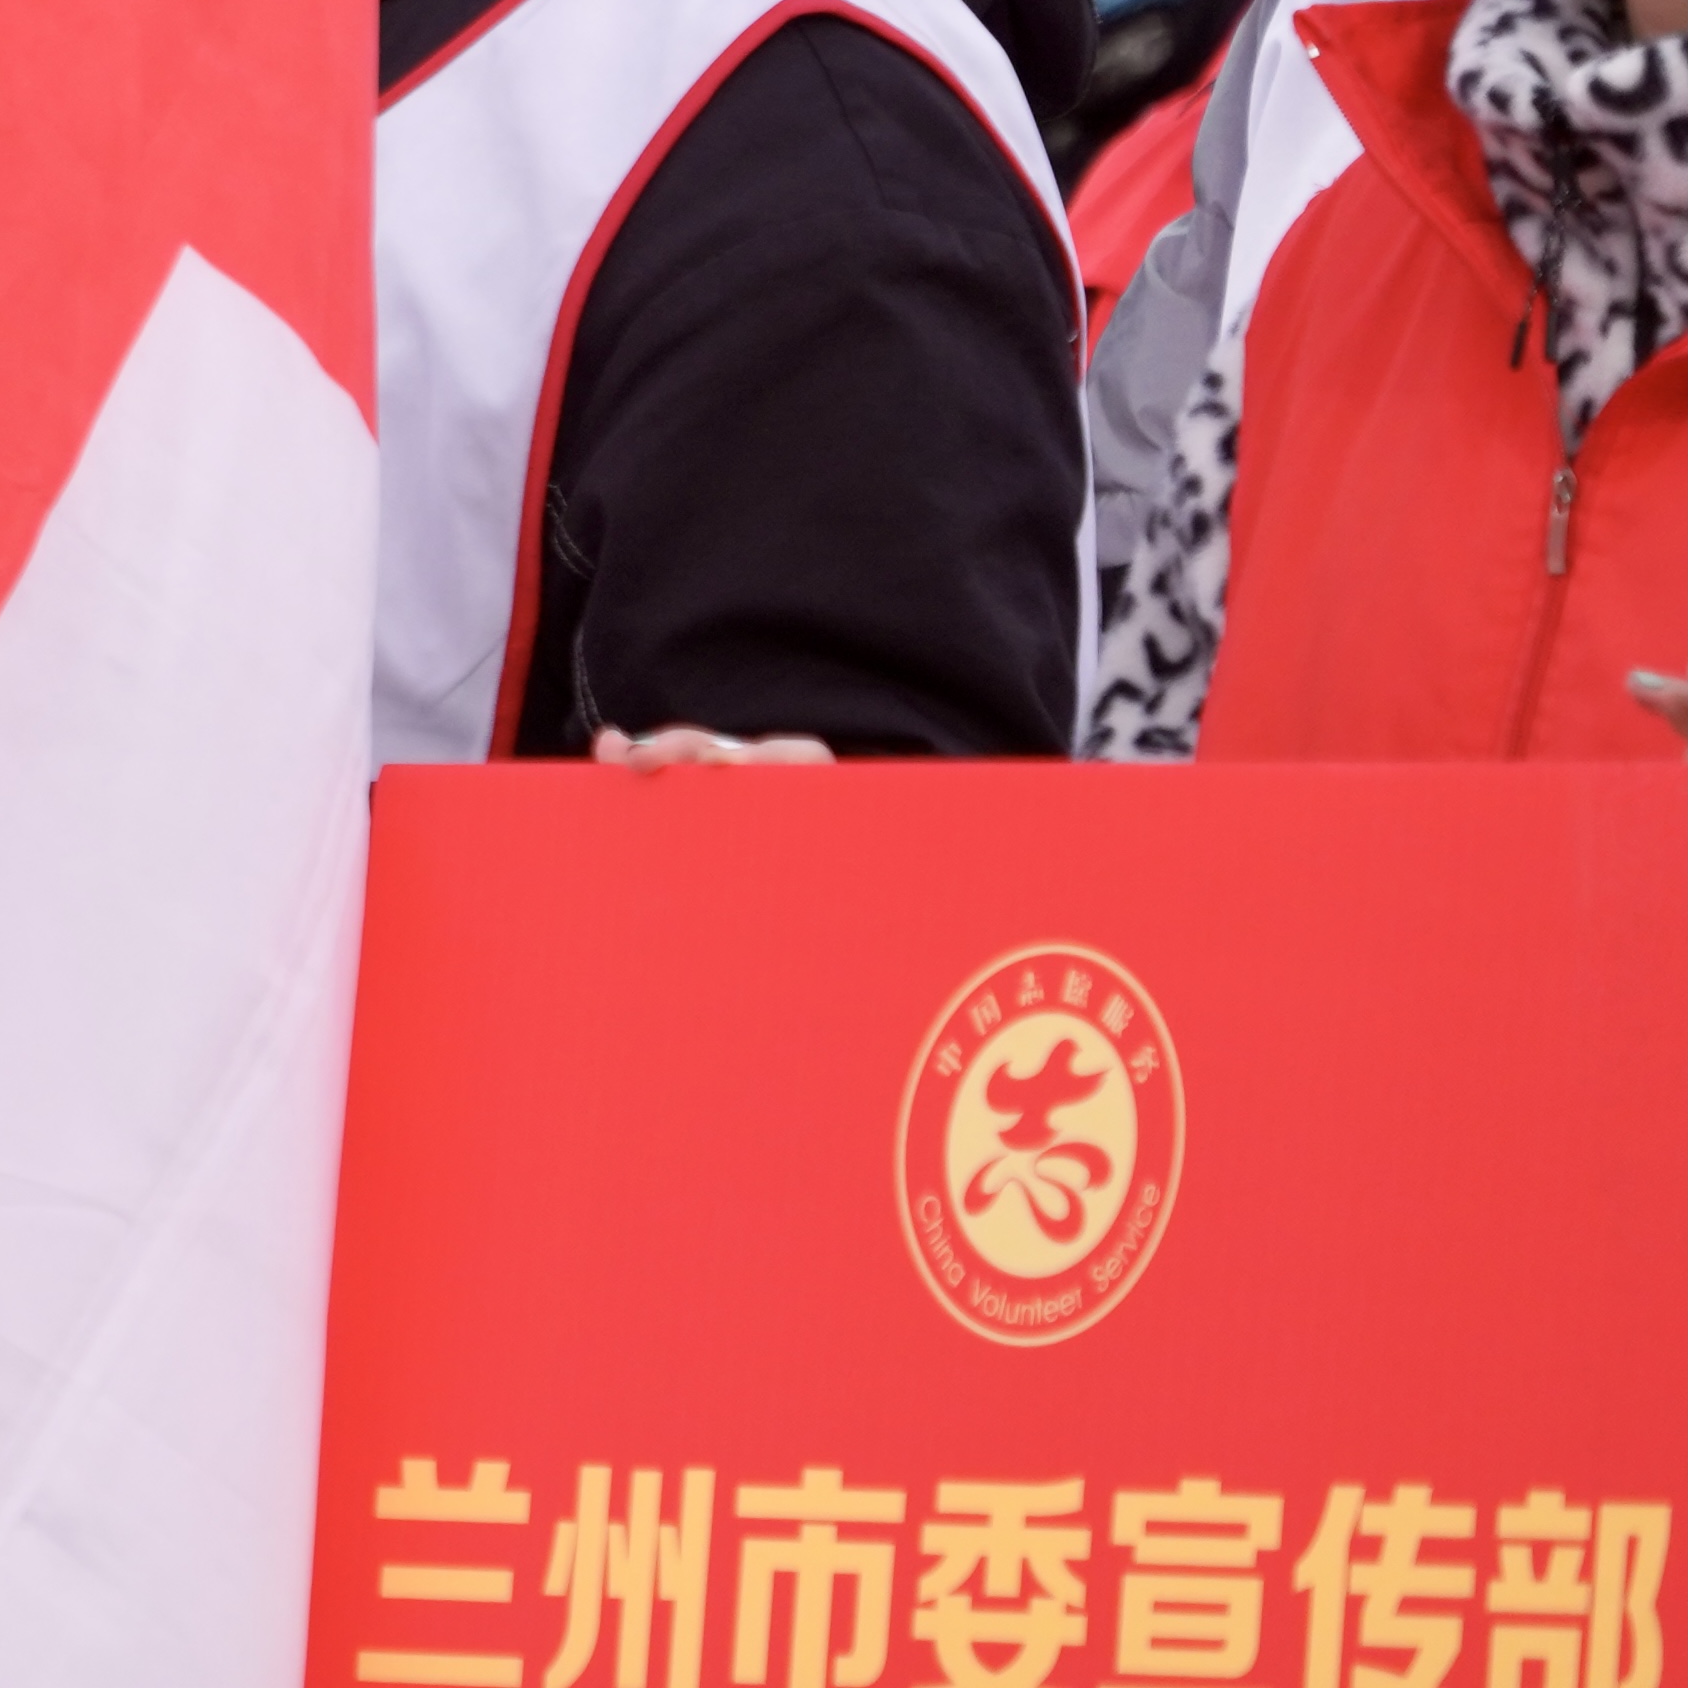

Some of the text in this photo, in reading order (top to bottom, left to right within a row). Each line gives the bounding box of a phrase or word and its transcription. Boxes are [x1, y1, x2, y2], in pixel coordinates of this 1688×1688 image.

[919, 1182, 1161, 1327] China Volunteer Service
[356, 1457, 1672, 1688] 兰州市委宣传部
